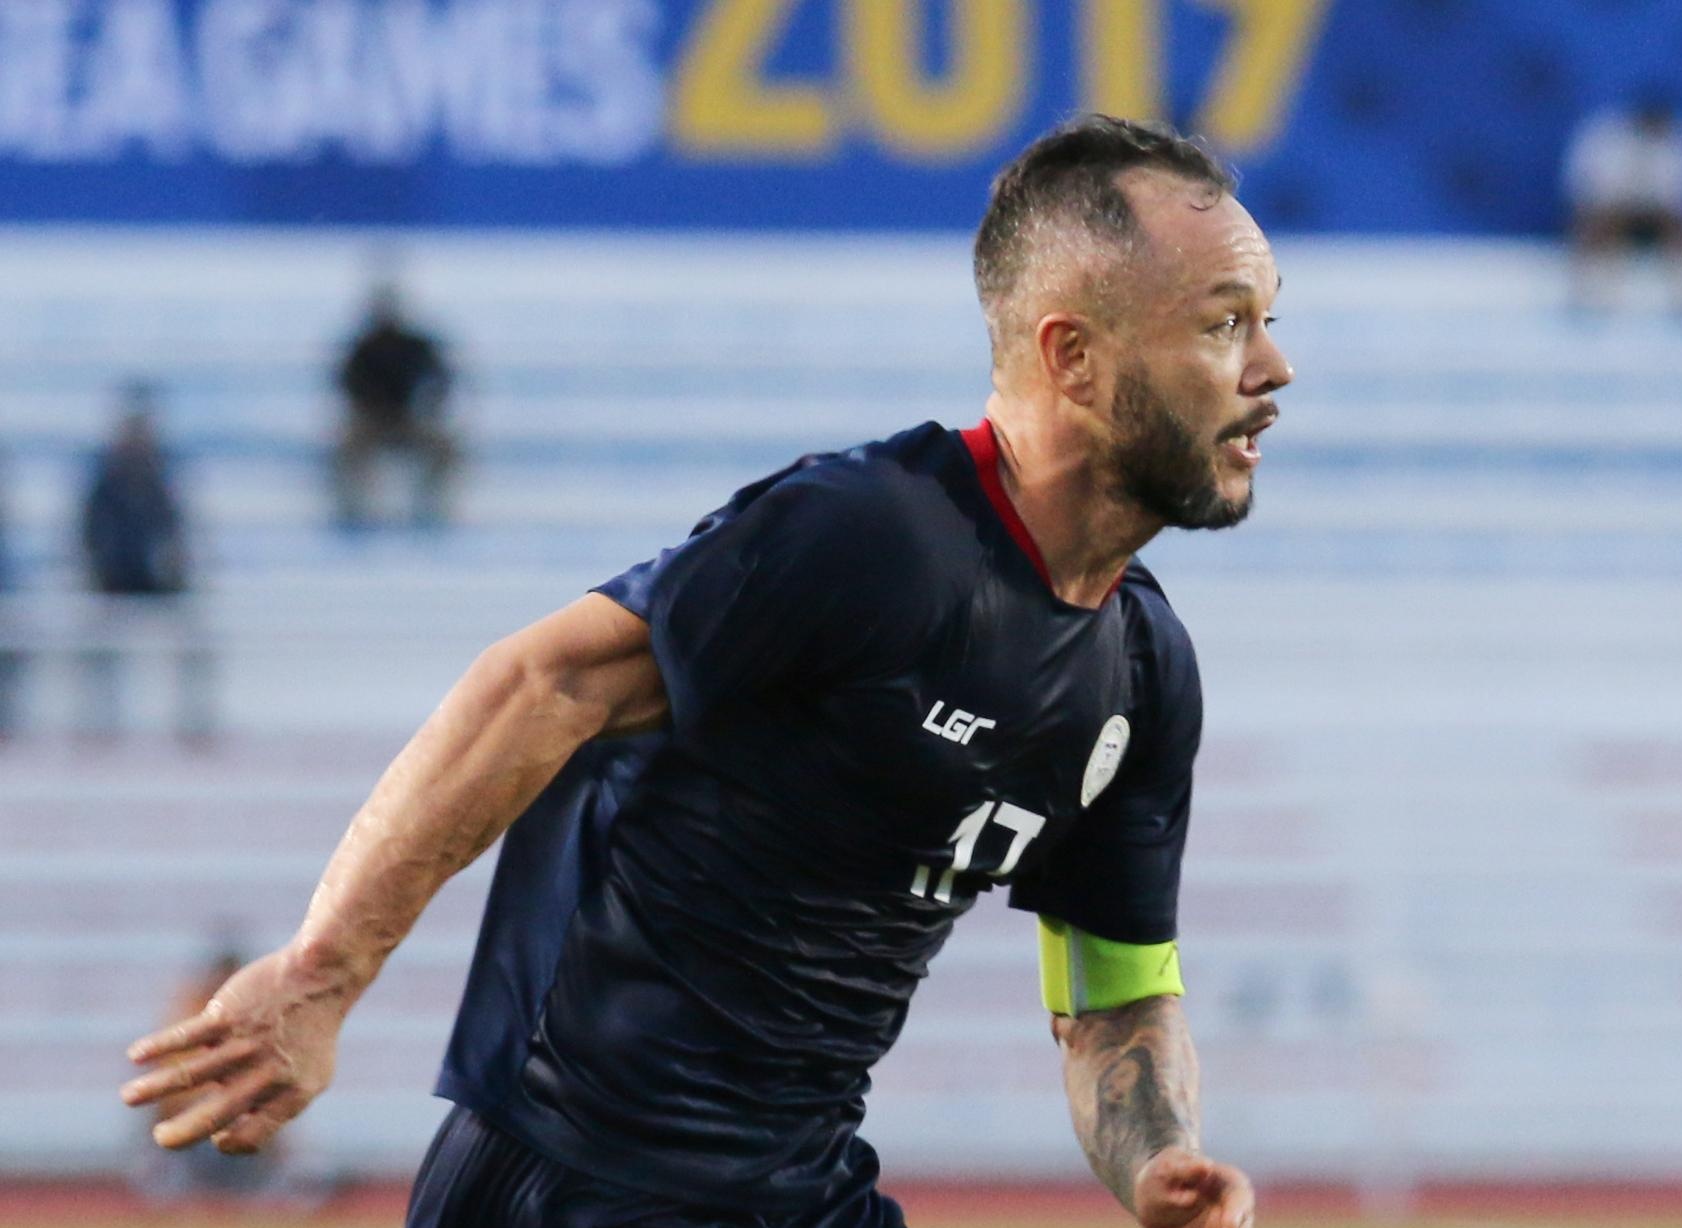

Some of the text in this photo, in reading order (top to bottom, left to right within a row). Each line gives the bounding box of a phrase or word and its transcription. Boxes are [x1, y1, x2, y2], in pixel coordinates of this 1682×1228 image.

[0, 0, 201, 160] EA
[203, 0, 657, 163] GAMES
[910, 800, 1047, 904] 17
